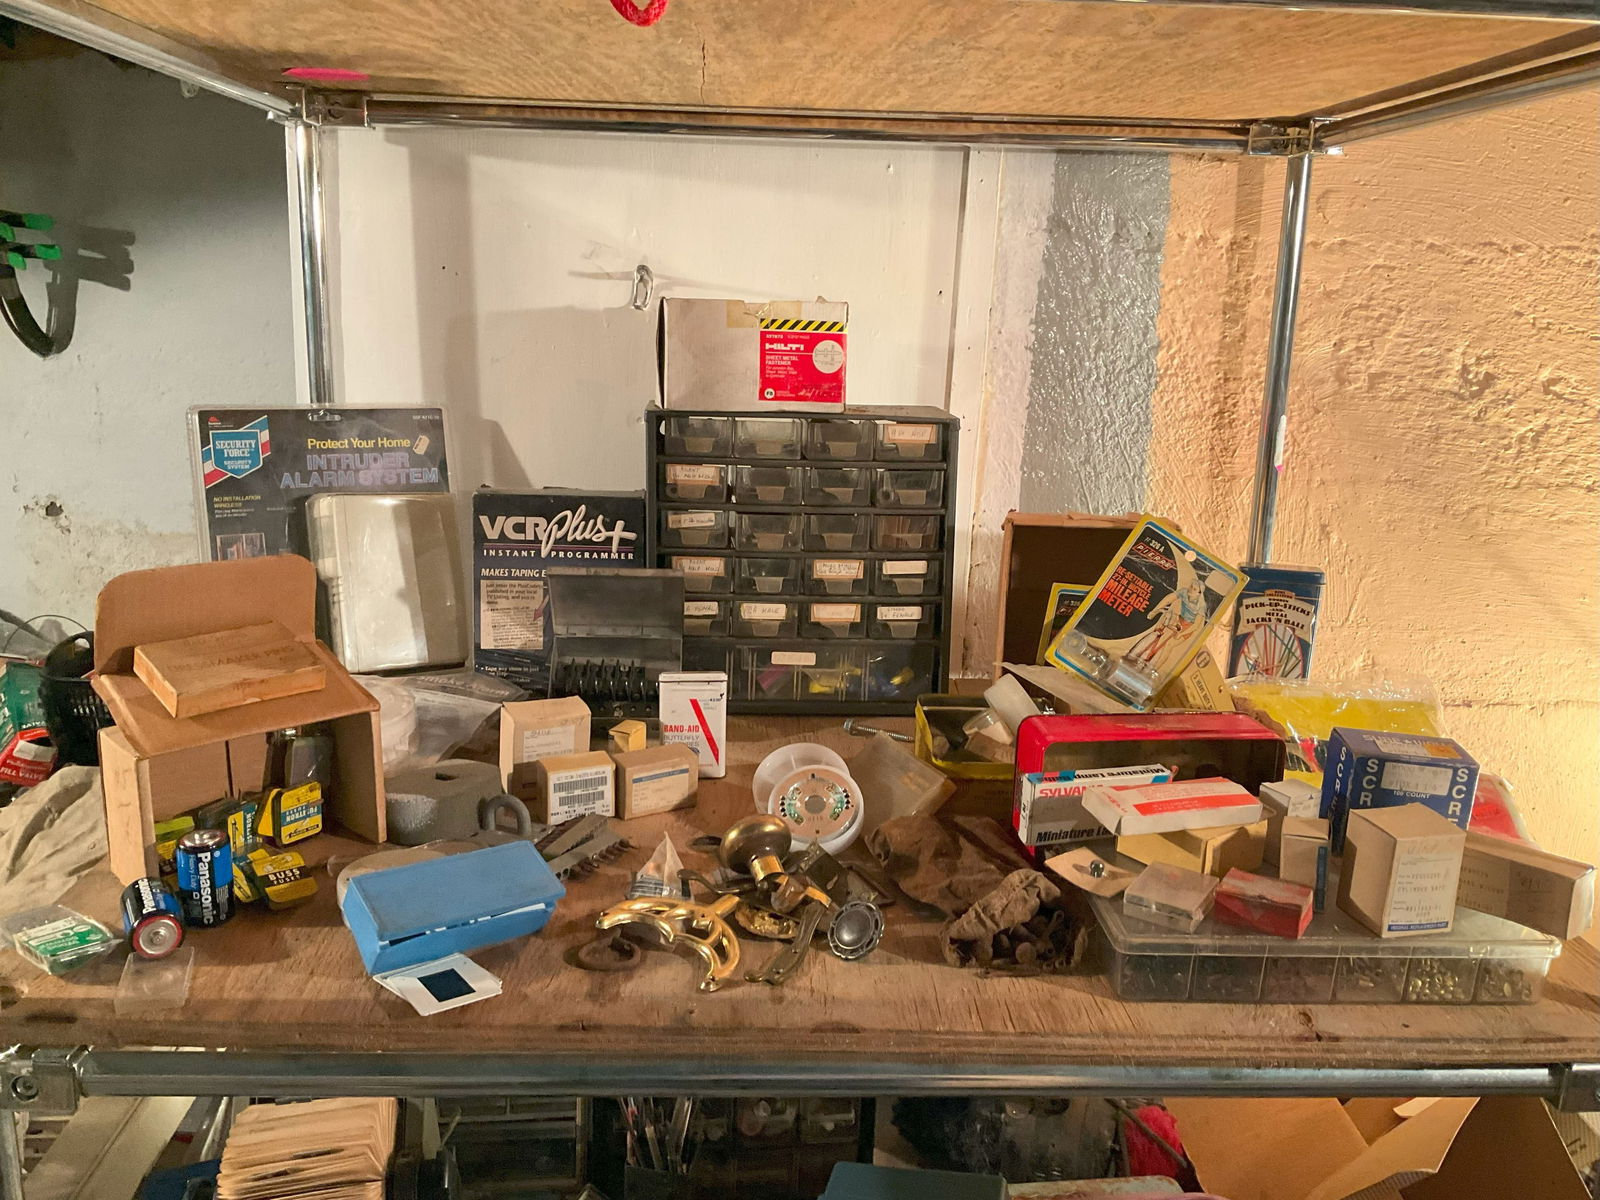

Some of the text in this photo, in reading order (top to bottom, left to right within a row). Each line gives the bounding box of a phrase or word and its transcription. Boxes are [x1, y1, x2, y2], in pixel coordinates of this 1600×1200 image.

[215, 439, 256, 449] SECURITY
[307, 436, 411, 449] Protect Your Home
[223, 449, 250, 458] FORCE
[306, 452, 410, 470] INTRUDER
[280, 467, 439, 488] ALARM SYSTEM
[479, 515, 547, 540] VCR
[483, 549, 634, 560] INSTANT PROGRAMMER
[1137, 544, 1171, 568] PIERRE
[480, 568, 508, 577] MAKES
[511, 568, 540, 578] TAPING
[1103, 578, 1150, 612] MILEAGE
[1097, 589, 1135, 617] METER
[1245, 601, 1311, 616] PICK-UP-STICKS
[663, 724, 700, 733] BAND-AID
[1074, 773, 1106, 781] Lamp
[1107, 767, 1166, 777] Miniature
[1405, 791, 1430, 799] COUNT
[1036, 827, 1093, 843] Miniature
[268, 868, 300, 881] BUSS
[197, 851, 213, 925] Panasonic
